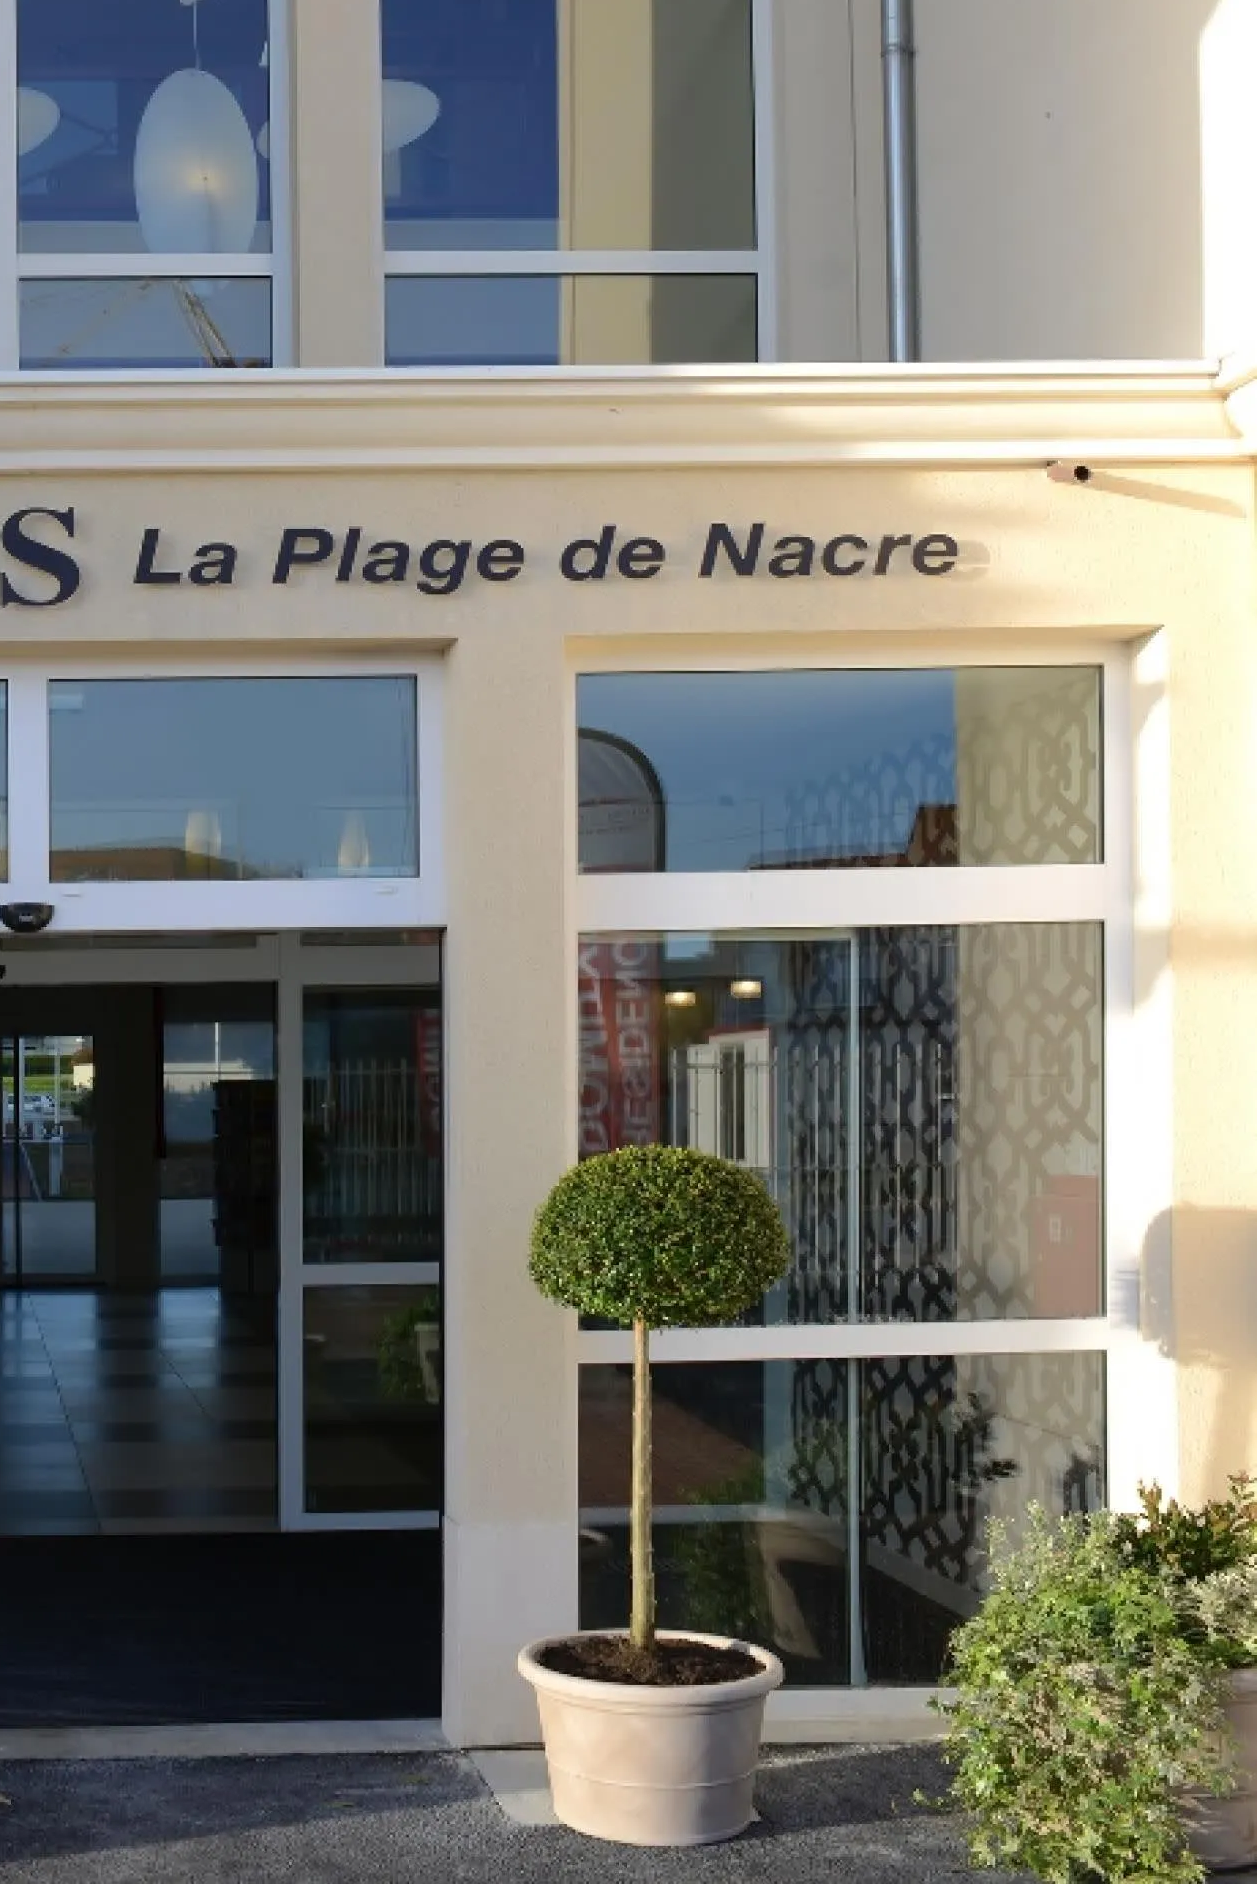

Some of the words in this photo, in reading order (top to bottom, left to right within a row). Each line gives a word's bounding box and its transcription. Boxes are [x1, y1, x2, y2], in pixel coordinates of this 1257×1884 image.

[133, 528, 238, 585] La
[273, 525, 525, 596] Plage
[560, 522, 665, 581] de
[699, 521, 959, 579] Nacre
